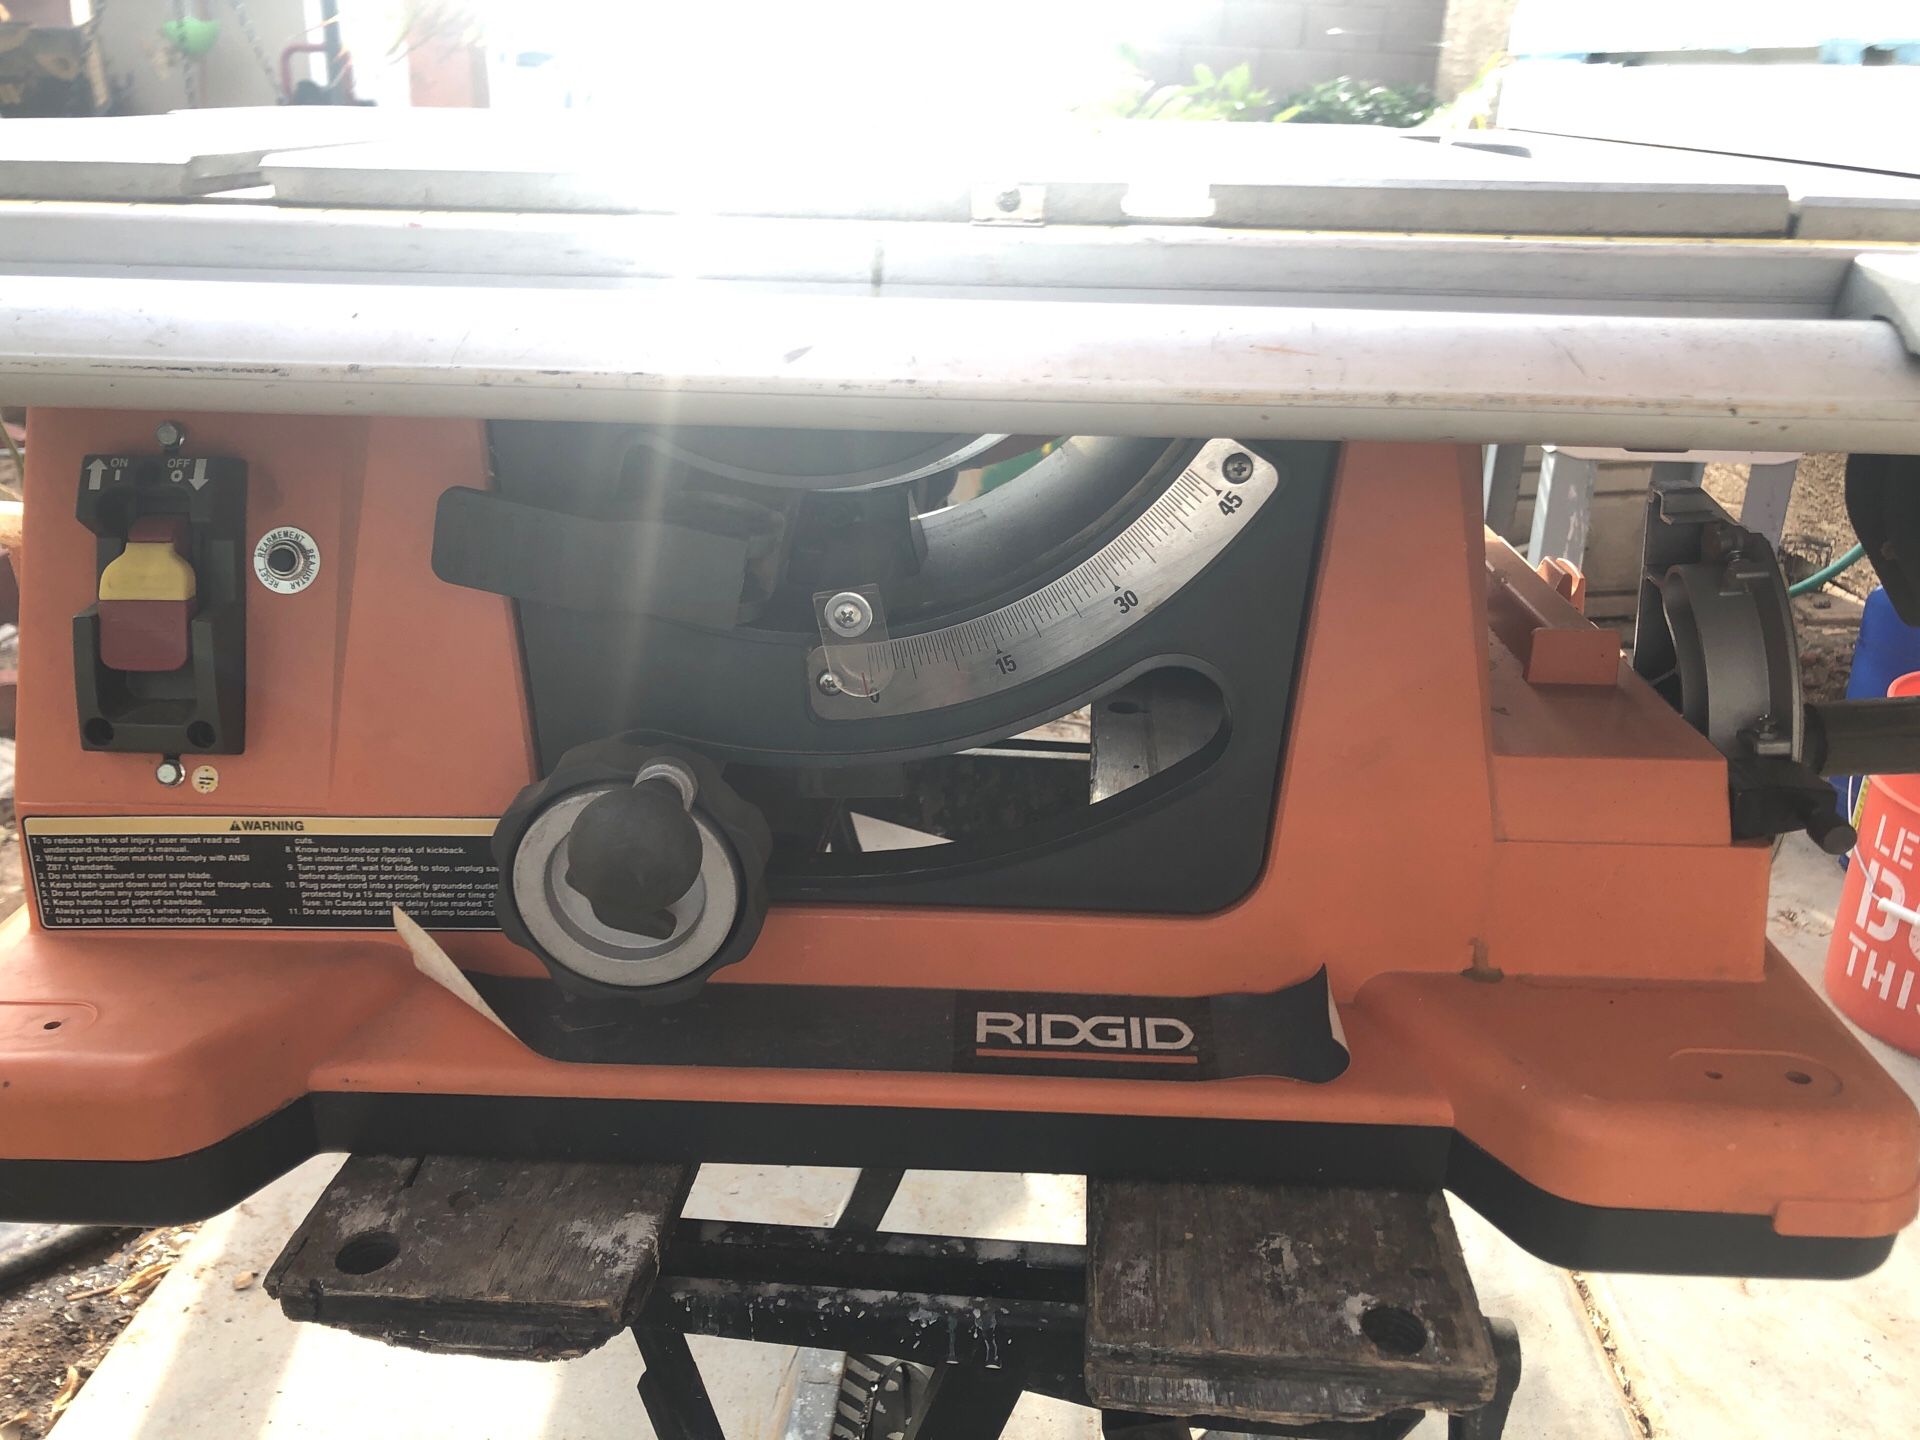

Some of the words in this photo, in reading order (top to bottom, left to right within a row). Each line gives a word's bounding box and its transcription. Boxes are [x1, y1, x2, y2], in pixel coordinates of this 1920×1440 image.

[110, 458, 128, 468] ON
[167, 458, 191, 468] OFF
[1218, 490, 1243, 516] 45
[257, 530, 306, 559] REARMEMENT
[290, 548, 316, 589] REAJUSTAR
[258, 568, 280, 588] RESET
[1113, 589, 1139, 614] 30
[995, 654, 1017, 675] 15
[241, 821, 304, 831] WARNING
[86, 855, 130, 863] protection
[176, 854, 207, 863] comply
[317, 865, 344, 873] power
[420, 864, 429, 872] to
[454, 865, 484, 874] unplug
[327, 873, 367, 882] adjusting
[50, 882, 72, 890] Keep
[98, 882, 124, 890] guard
[179, 882, 202, 890] place
[217, 882, 251, 890] through
[299, 882, 319, 890] Plug
[320, 883, 346, 891] power
[394, 882, 430, 891] properly
[432, 882, 473, 891] grounded
[81, 890, 115, 898] perform
[134, 890, 175, 898] operation
[301, 891, 341, 900] protected
[342, 891, 353, 900] by
[374, 892, 393, 900] amp
[52, 899, 75, 907] Keep
[131, 899, 151, 907] path
[405, 900, 429, 909] delay
[54, 908, 84, 916] Always
[111, 908, 133, 916] push
[181, 908, 211, 916] ripping
[332, 909, 364, 917] expose
[431, 909, 455, 918] damp
[82, 917, 103, 925] push
[222, 917, 273, 925] non-through
[1847, 931, 1920, 1012] THI
[975, 1011, 1195, 1050] RIDGID
